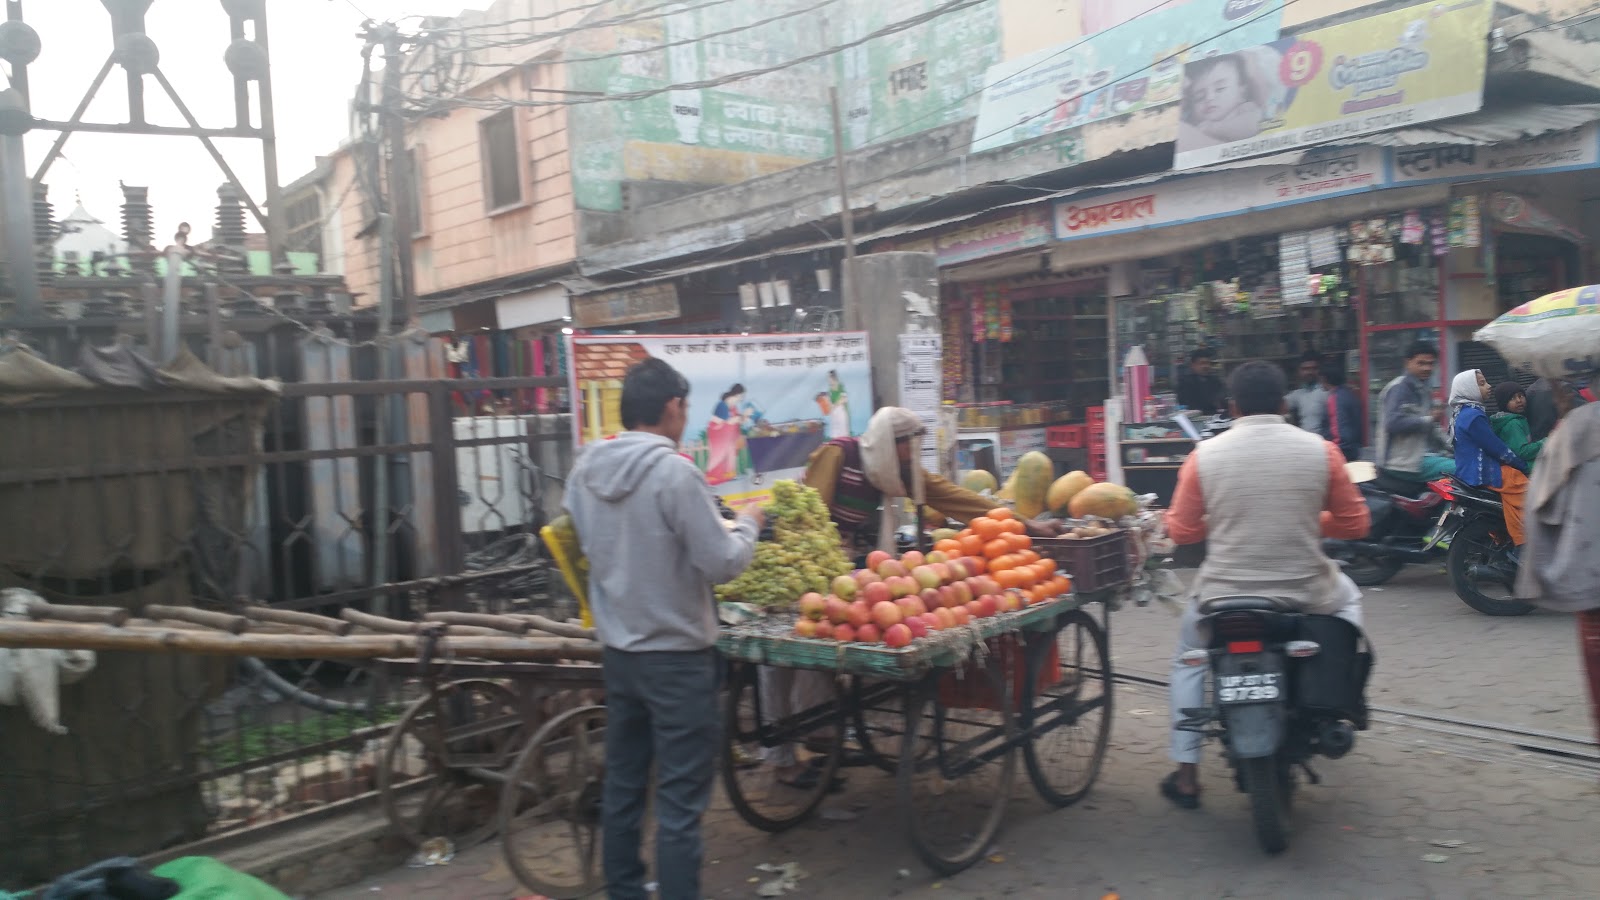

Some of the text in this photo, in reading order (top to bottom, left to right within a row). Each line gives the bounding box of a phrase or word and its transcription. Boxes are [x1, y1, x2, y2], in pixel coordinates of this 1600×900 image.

[1290, 51, 1309, 80] 9
[1221, 133, 1298, 158] AGGARWAL
[1365, 109, 1416, 130] STORE
[1065, 194, 1157, 232] अग्रवाल
[1219, 685, 1279, 701] 9739
[1220, 676, 1243, 687] UP
